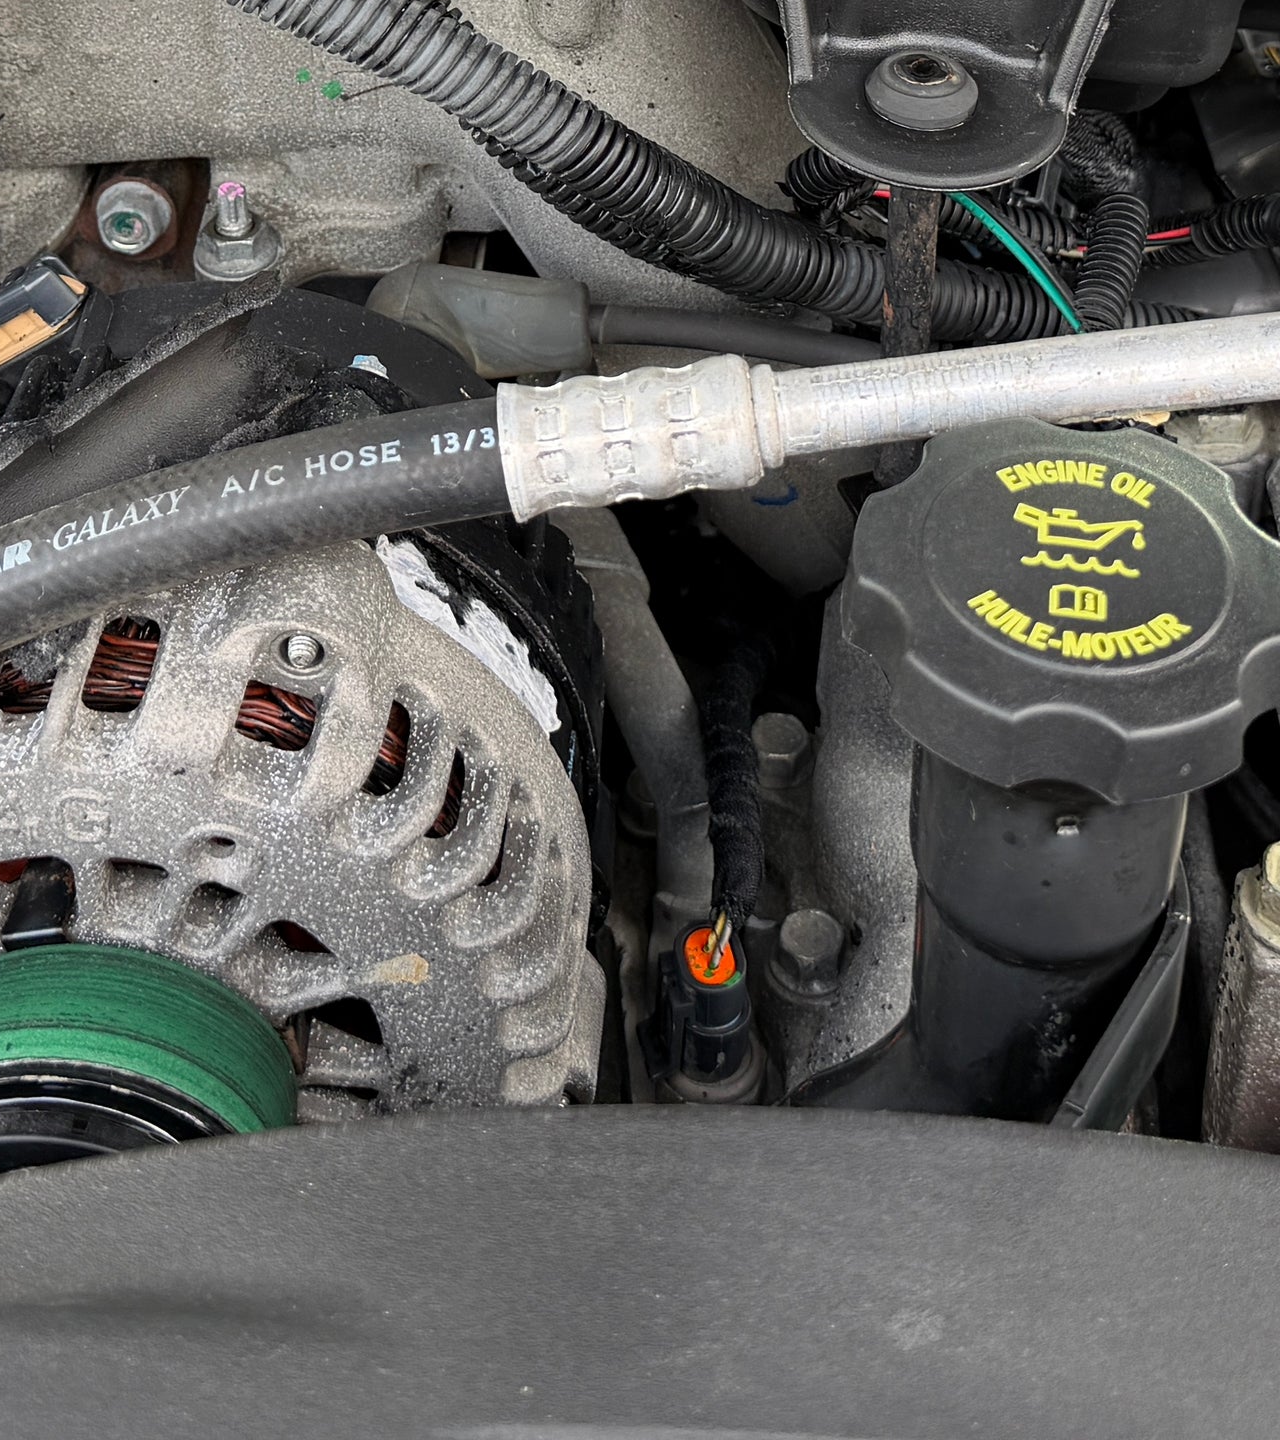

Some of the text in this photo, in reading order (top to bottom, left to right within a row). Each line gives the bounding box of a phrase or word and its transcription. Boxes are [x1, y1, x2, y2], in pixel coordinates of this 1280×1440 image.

[52, 486, 192, 551] GALAXY
[221, 464, 286, 499] A/C
[305, 439, 402, 479] HOSE
[995, 459, 1157, 509] ENGINE OIL
[967, 589, 1192, 660] HUILE-MOTEUR
